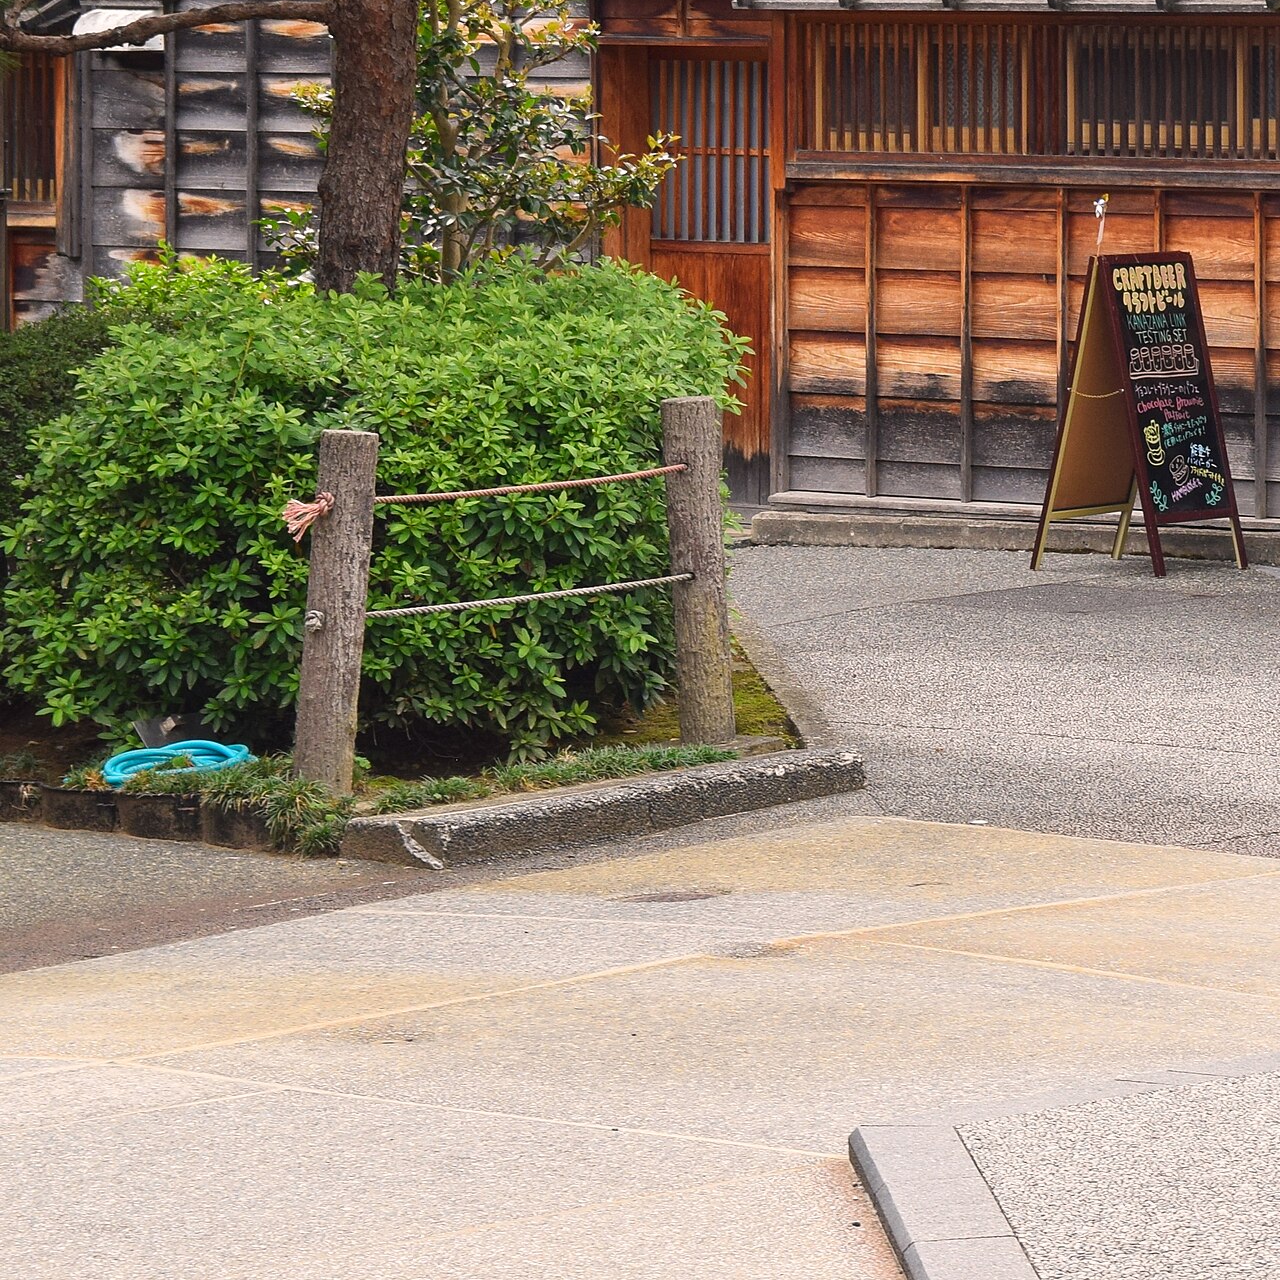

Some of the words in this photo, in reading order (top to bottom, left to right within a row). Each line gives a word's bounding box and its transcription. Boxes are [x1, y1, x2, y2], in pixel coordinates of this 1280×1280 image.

[1122, 289, 1185, 314] クラフトビール
[1126, 314, 1167, 330] KANAZAWA
[1169, 313, 1186, 328] LINK
[1136, 330, 1172, 344] TESTING
[1173, 328, 1188, 343] SET
[1137, 397, 1175, 414] Chocolate
[1176, 395, 1205, 411] Brownie
